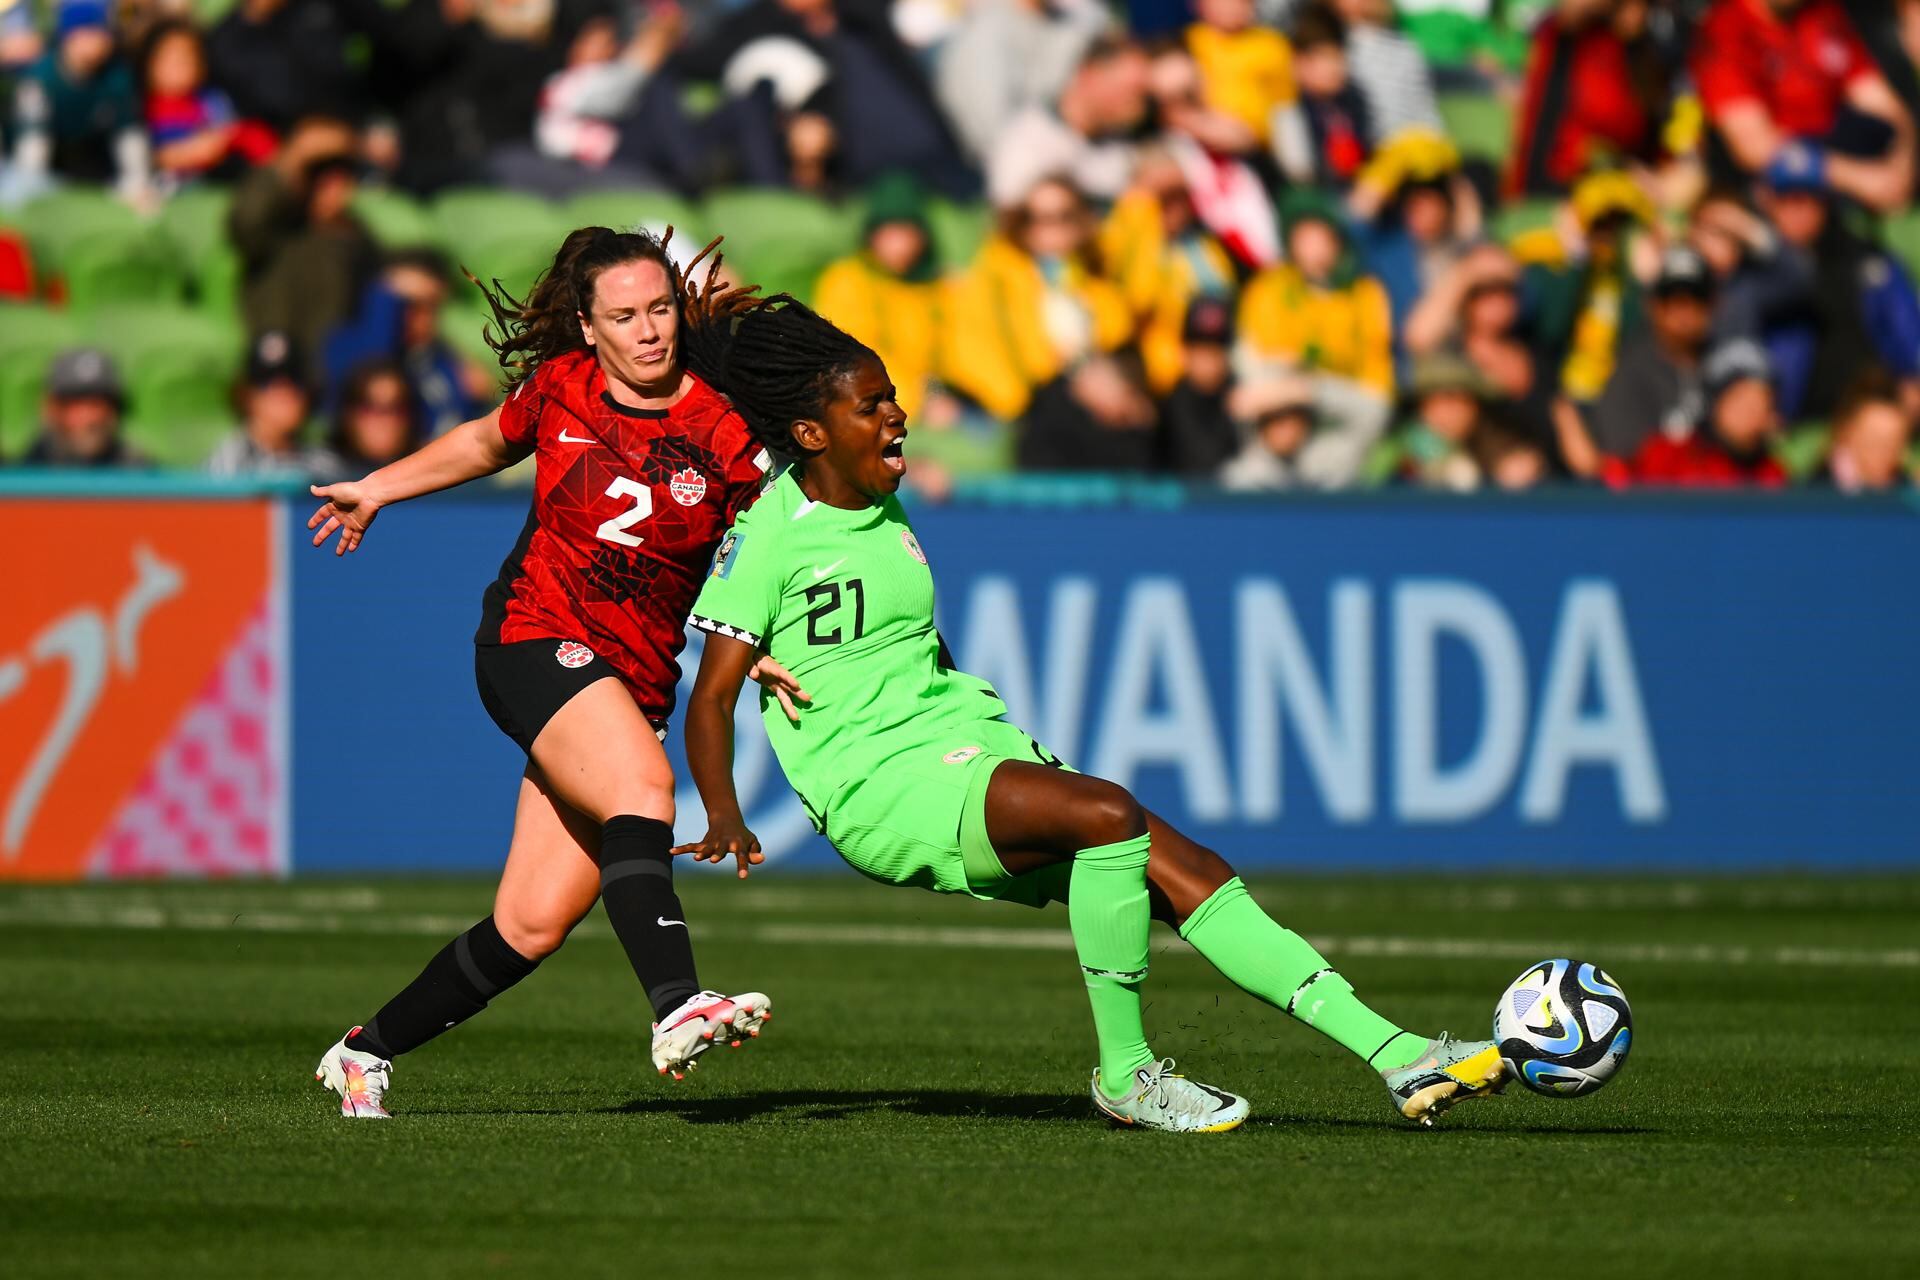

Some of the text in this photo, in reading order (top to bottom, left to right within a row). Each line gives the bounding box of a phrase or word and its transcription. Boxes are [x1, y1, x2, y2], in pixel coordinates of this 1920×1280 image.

[596, 476, 652, 547] 2
[671, 483, 704, 492] CANADA
[805, 579, 864, 645] 21
